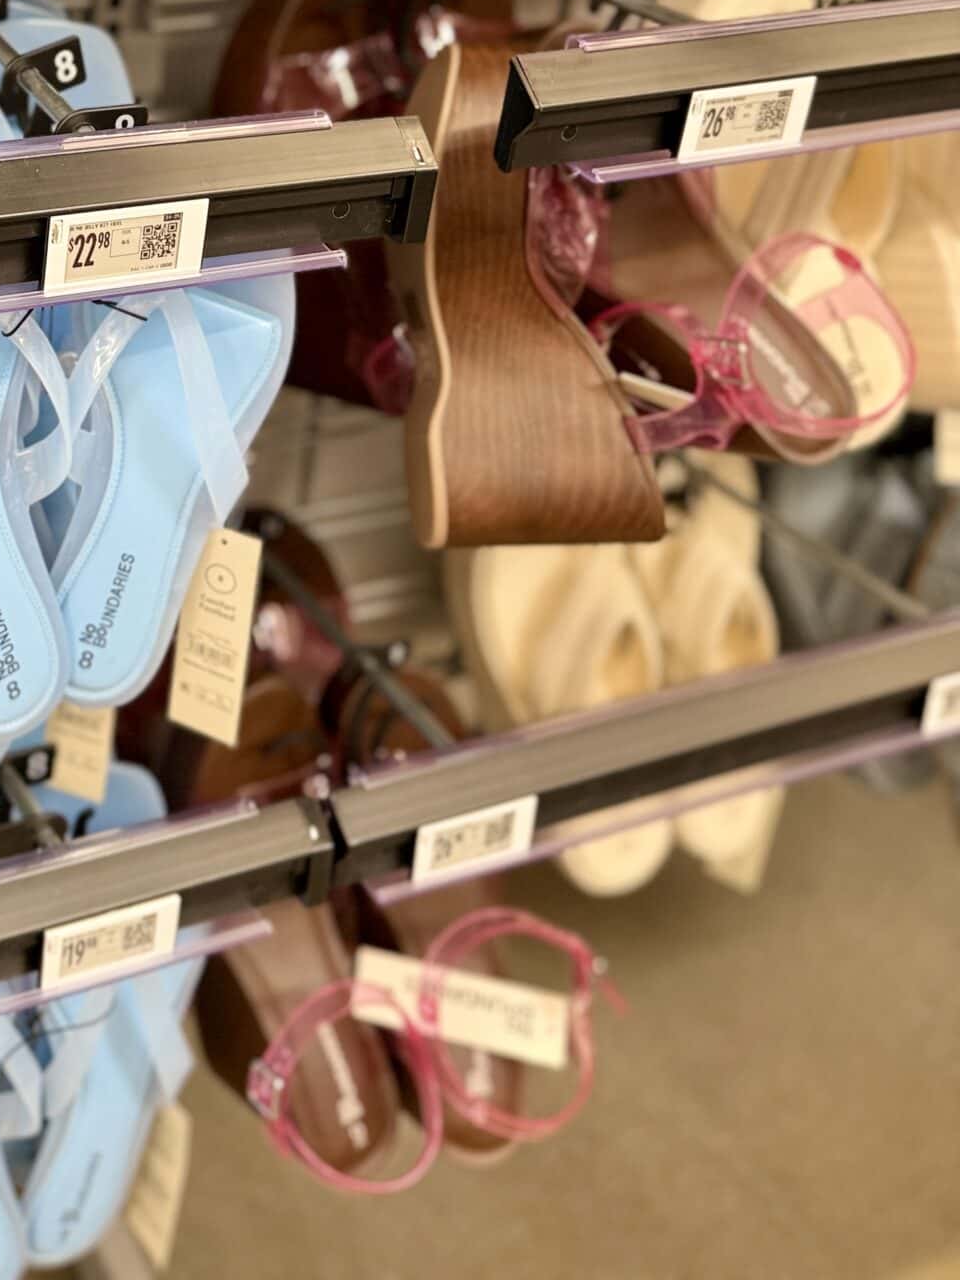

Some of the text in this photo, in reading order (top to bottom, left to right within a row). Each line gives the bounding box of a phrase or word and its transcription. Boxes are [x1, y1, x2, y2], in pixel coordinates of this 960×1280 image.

[54, 49, 78, 83] 8
[93, 552, 135, 648] BOUNDARIES
[79, 623, 96, 645] NO
[78, 650, 94, 669] 8
[6, 681, 21, 700] 8
